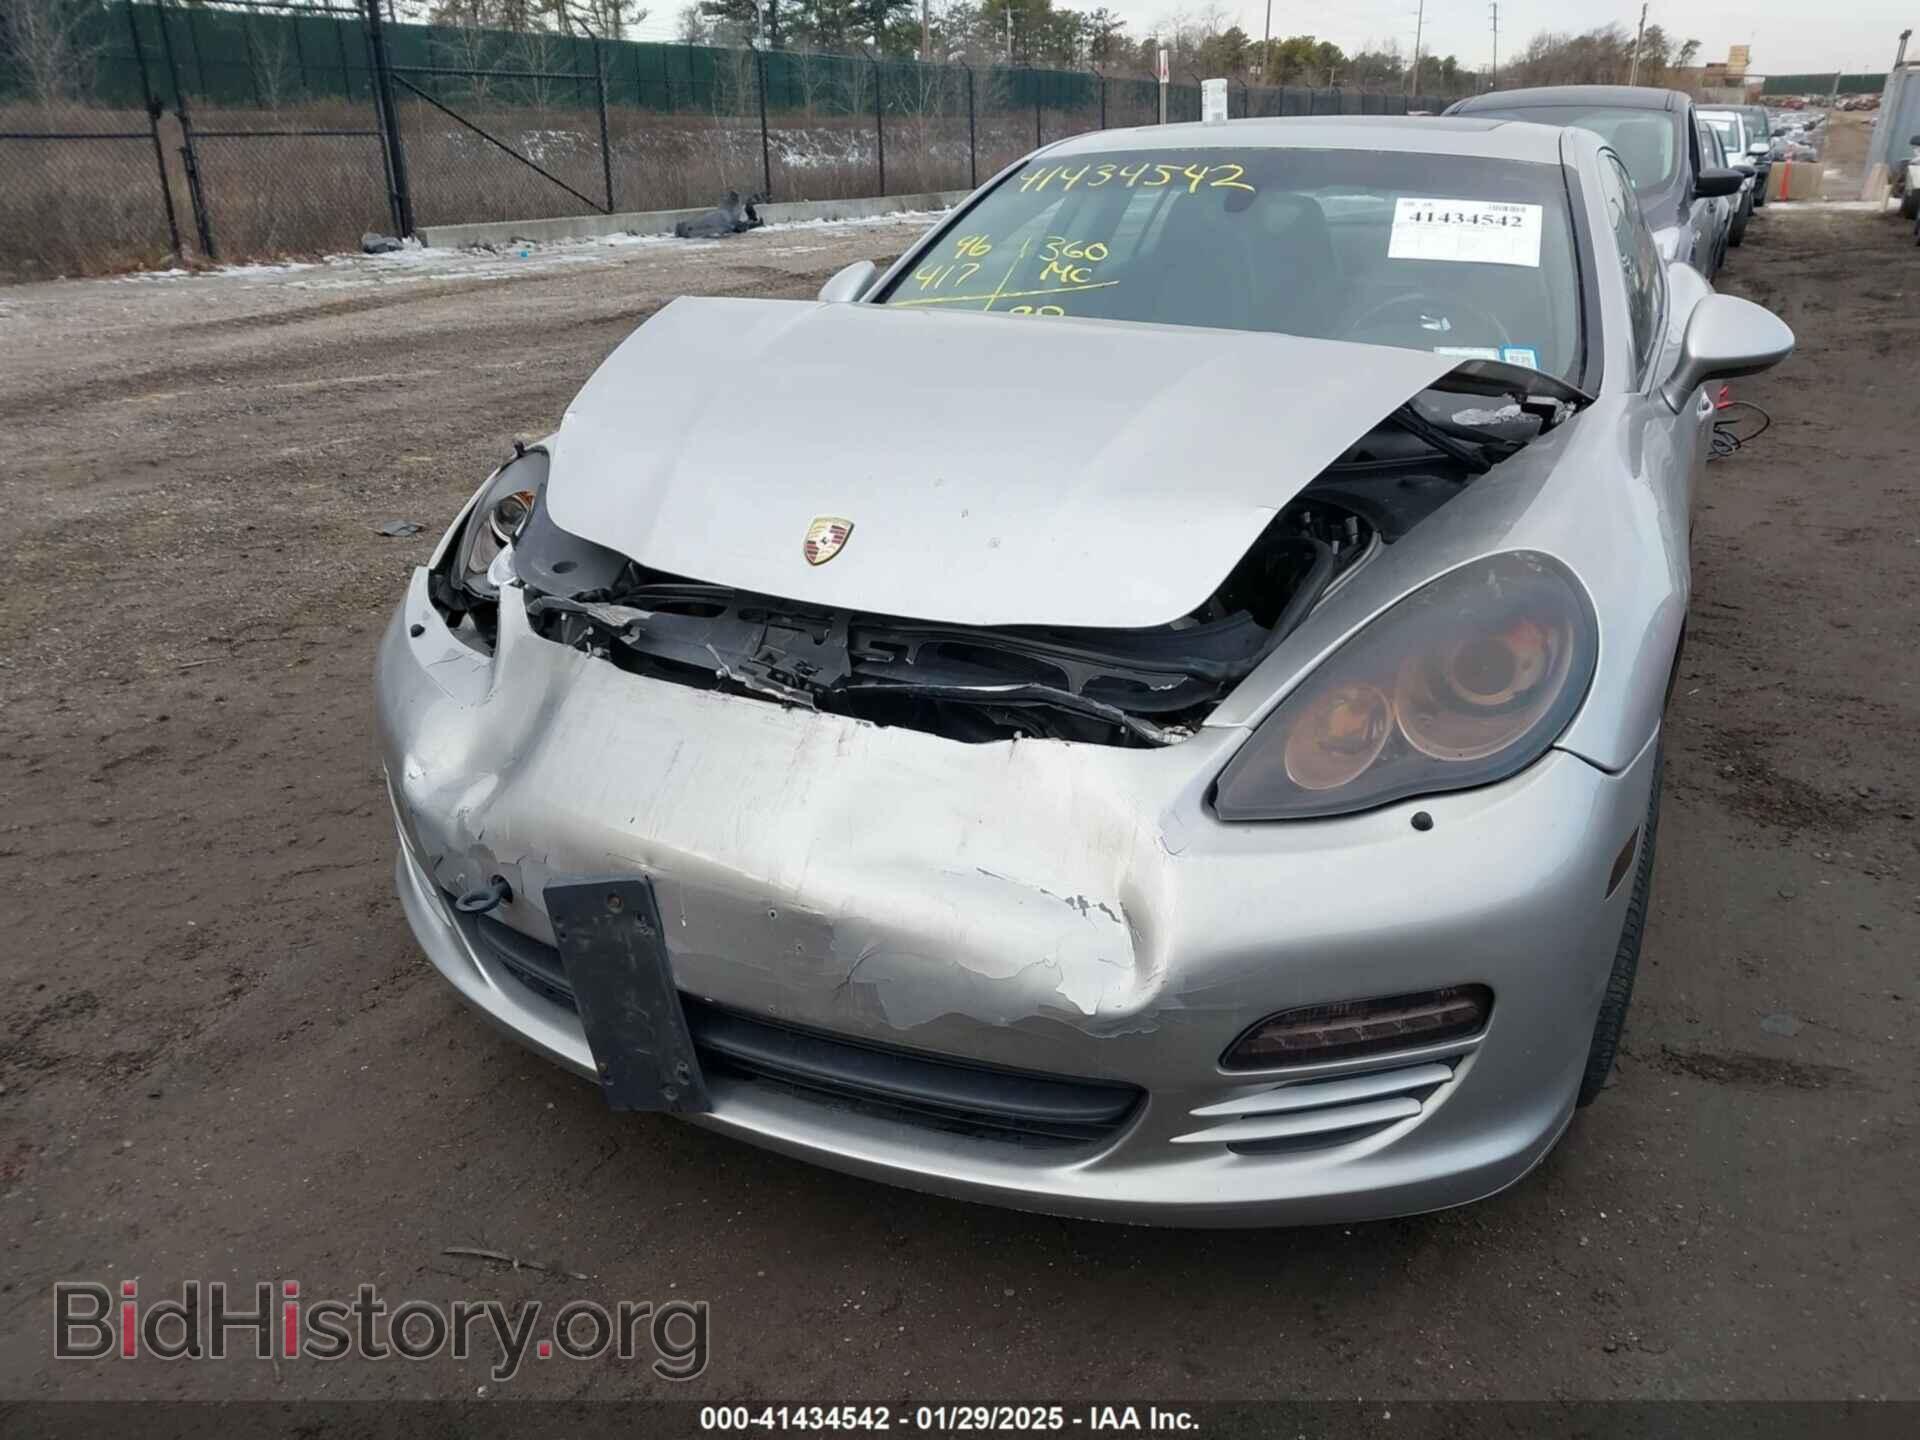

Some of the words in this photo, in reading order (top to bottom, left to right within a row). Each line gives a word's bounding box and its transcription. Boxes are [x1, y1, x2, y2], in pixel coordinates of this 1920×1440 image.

[1020, 163, 1257, 194] 41434542
[1408, 211, 1523, 227] 41434542
[1038, 235, 1109, 262] 360
[914, 262, 981, 292] 417
[1039, 261, 1096, 284] MC
